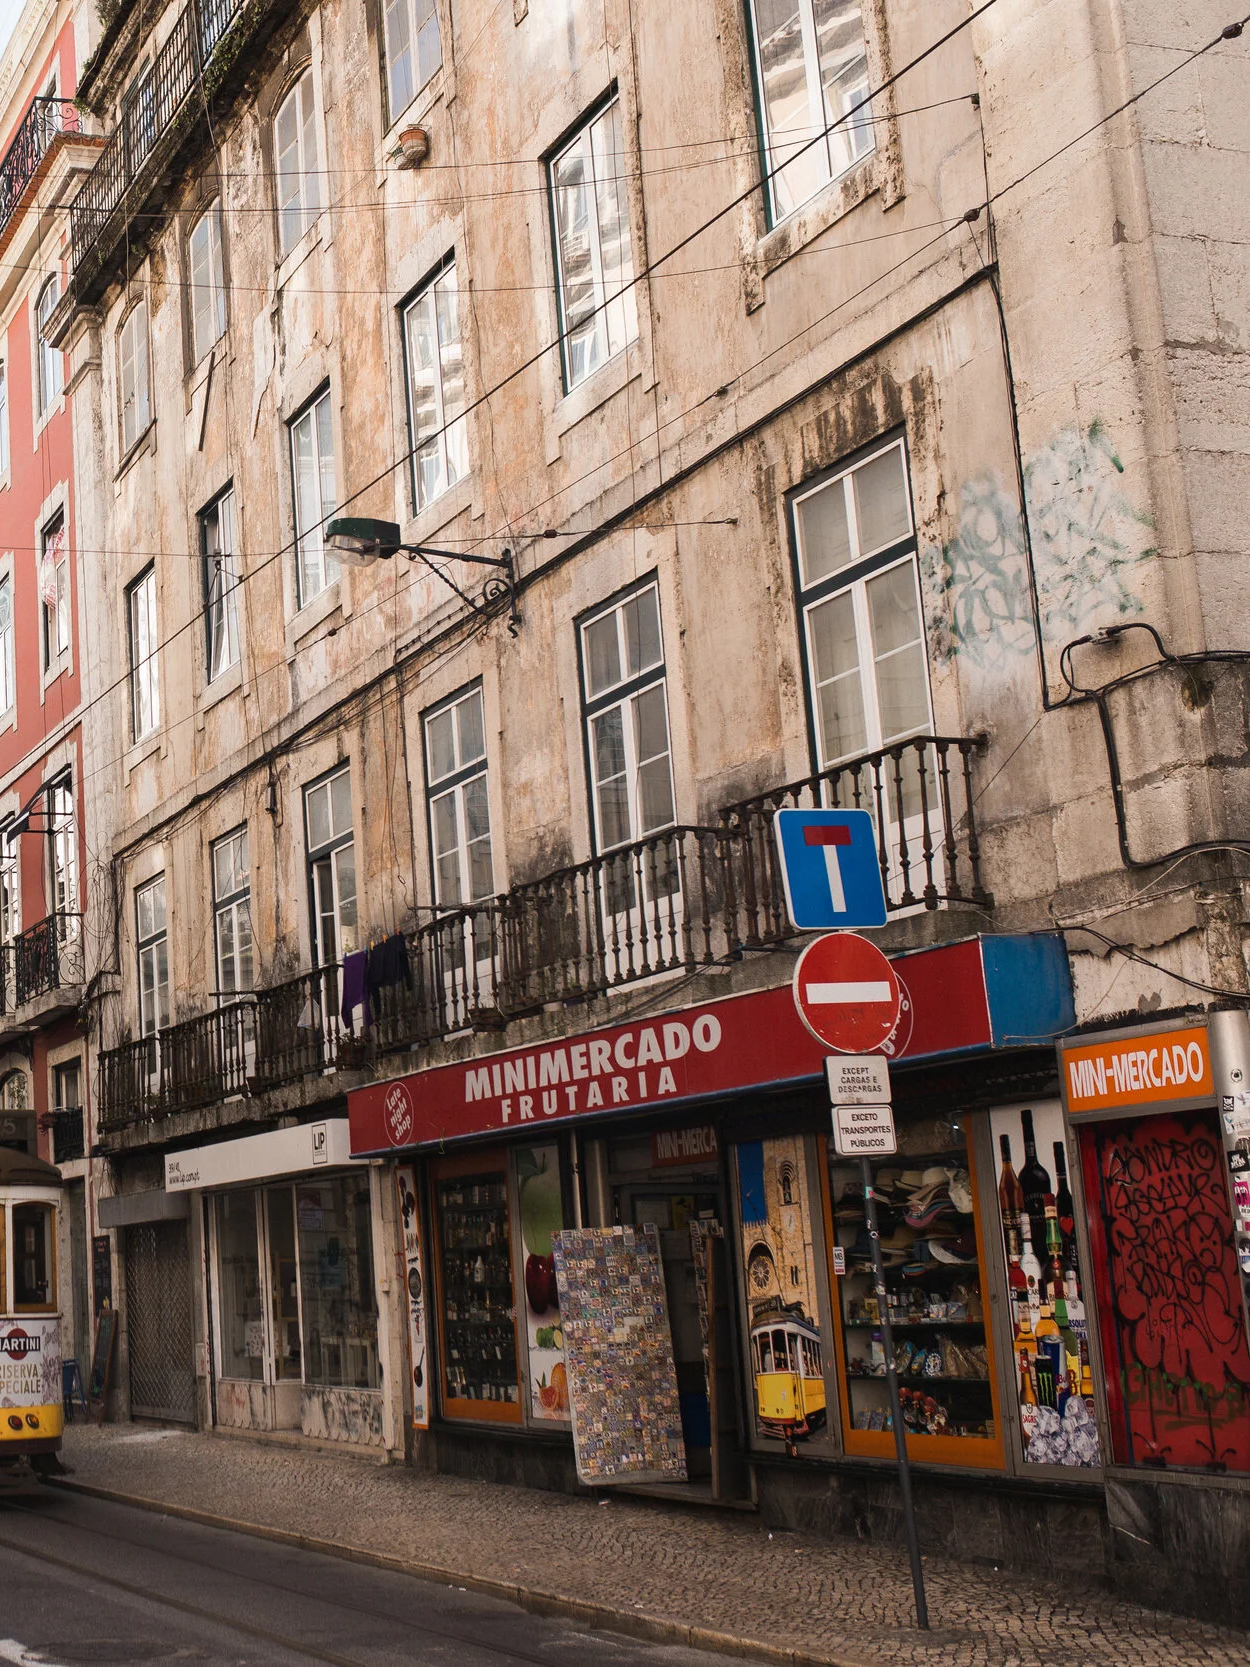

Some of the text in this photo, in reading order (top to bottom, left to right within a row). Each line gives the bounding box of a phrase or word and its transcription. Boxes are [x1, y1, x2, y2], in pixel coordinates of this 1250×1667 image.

[465, 1014, 722, 1103] MINIMERCADO
[1069, 1041, 1204, 1099] MINI-MERCADO
[841, 1076, 870, 1084] CARGAS
[386, 1088, 402, 1110] Late
[501, 1066, 677, 1123] FRUTARIA
[390, 1097, 408, 1127] night
[851, 1113, 878, 1121] EXCETO
[395, 1114, 411, 1140] shop
[841, 1125, 891, 1135] TRANSPORTES
[313, 1132, 325, 1150] LIP
[656, 1125, 718, 1159] MINI-MERCA
[850, 1138, 885, 1148] PÚBLICOS
